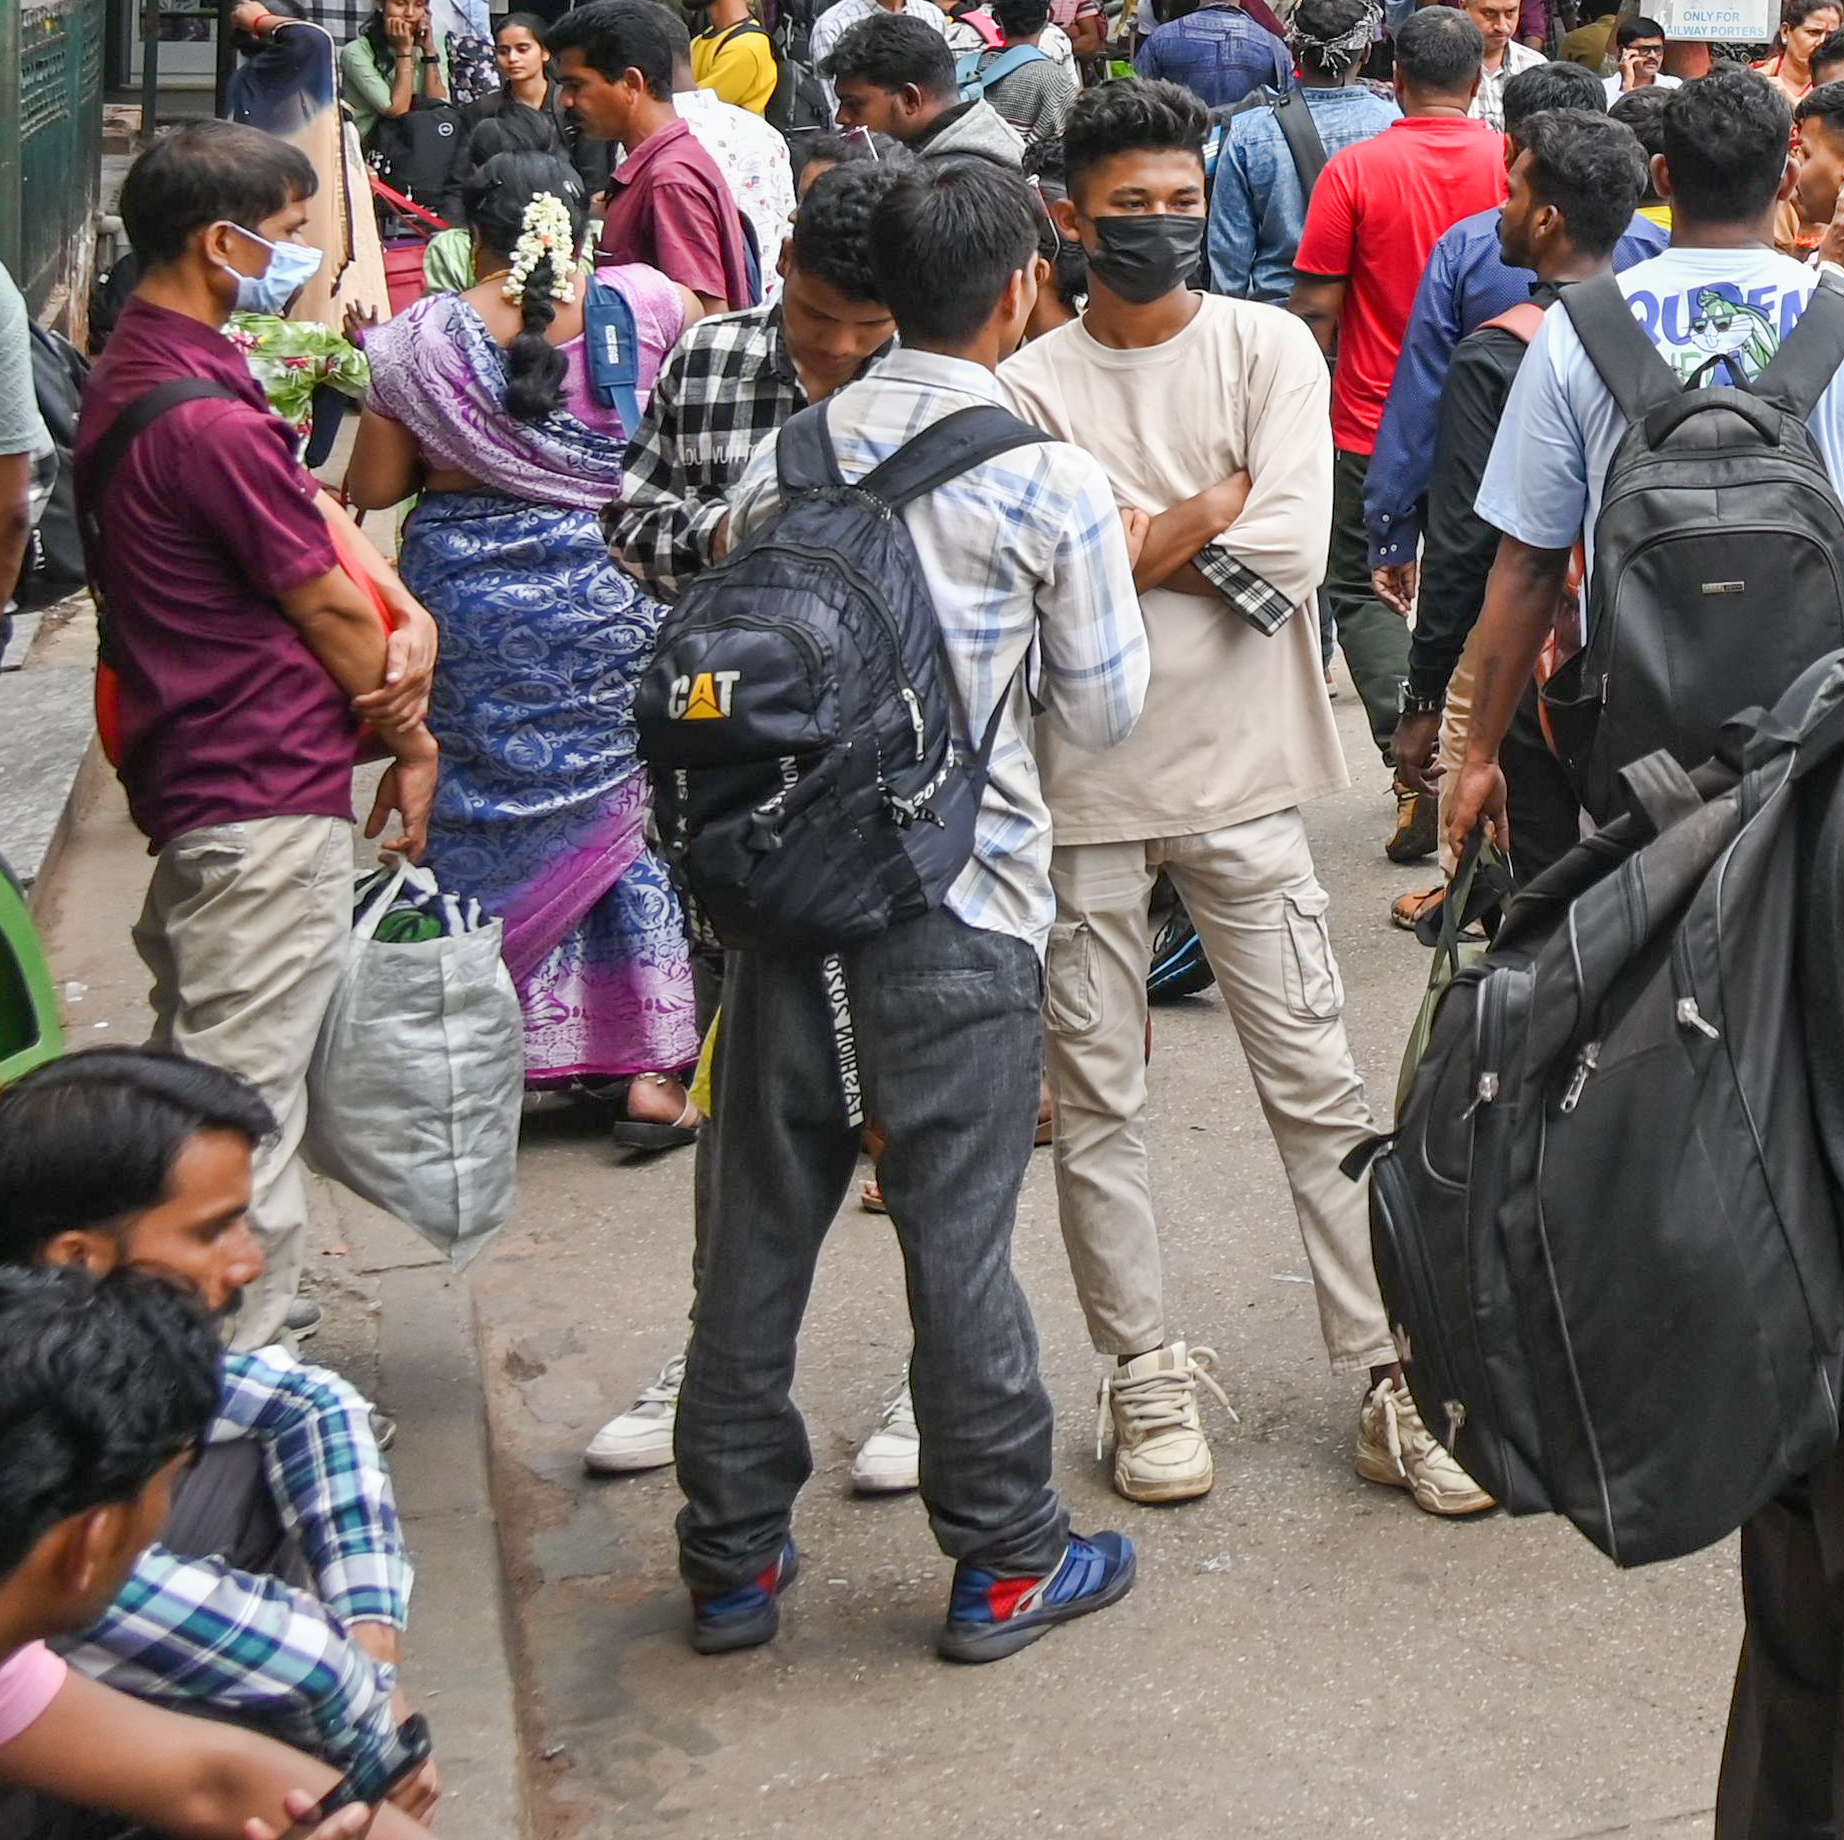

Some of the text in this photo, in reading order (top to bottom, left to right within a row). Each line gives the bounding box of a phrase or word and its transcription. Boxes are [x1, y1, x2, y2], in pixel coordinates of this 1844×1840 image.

[1683, 11, 1740, 22] ONLY FOR
[1665, 26, 1765, 37] AILWAY PORTERS
[668, 670, 741, 720] CAT
